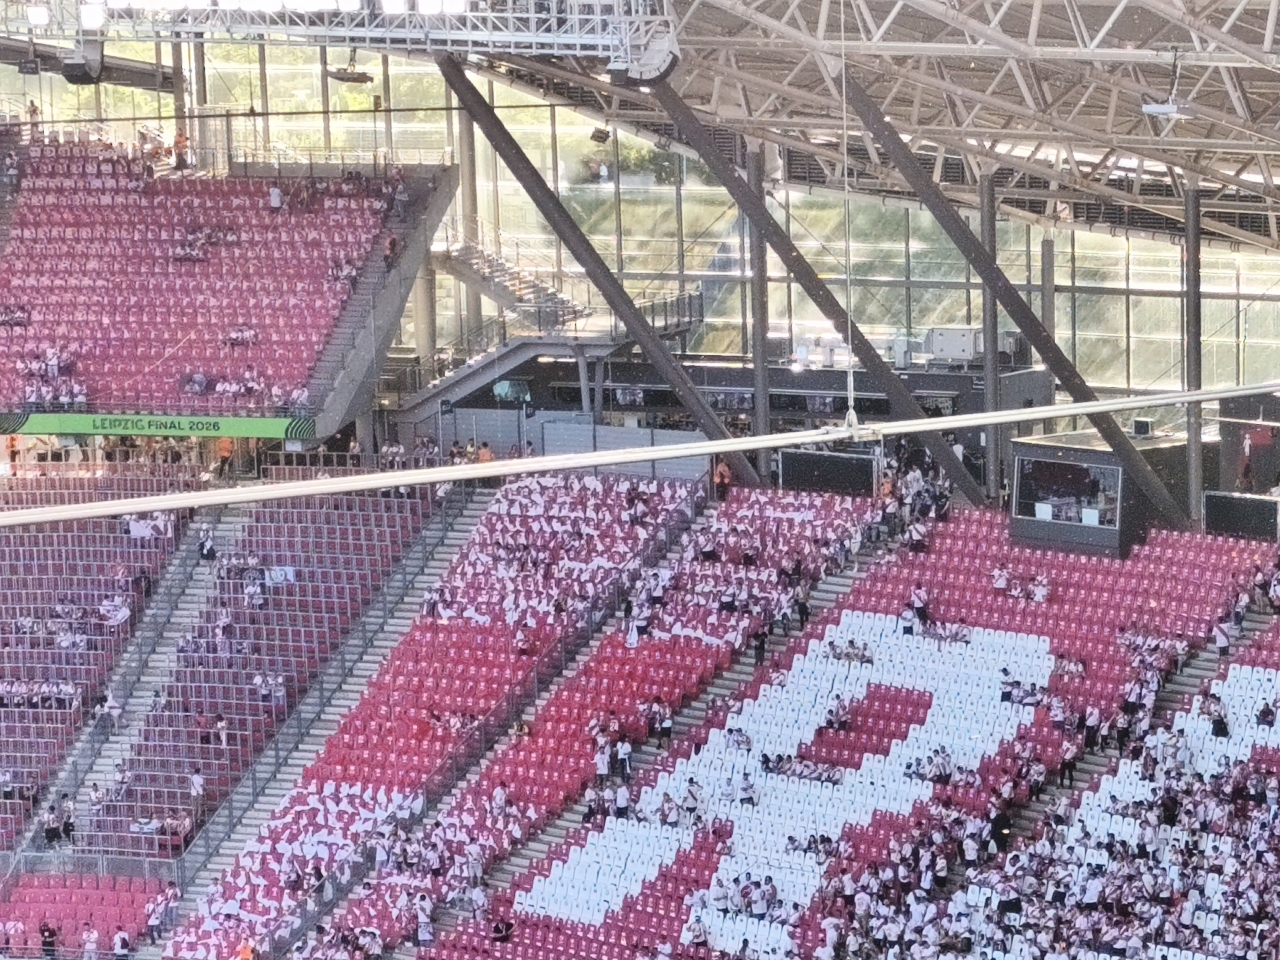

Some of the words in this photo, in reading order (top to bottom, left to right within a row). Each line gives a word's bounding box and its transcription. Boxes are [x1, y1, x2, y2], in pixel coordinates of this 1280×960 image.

[92, 418, 145, 431] LEIPZIG
[148, 419, 185, 431] FINAL
[188, 420, 220, 432] 2026
